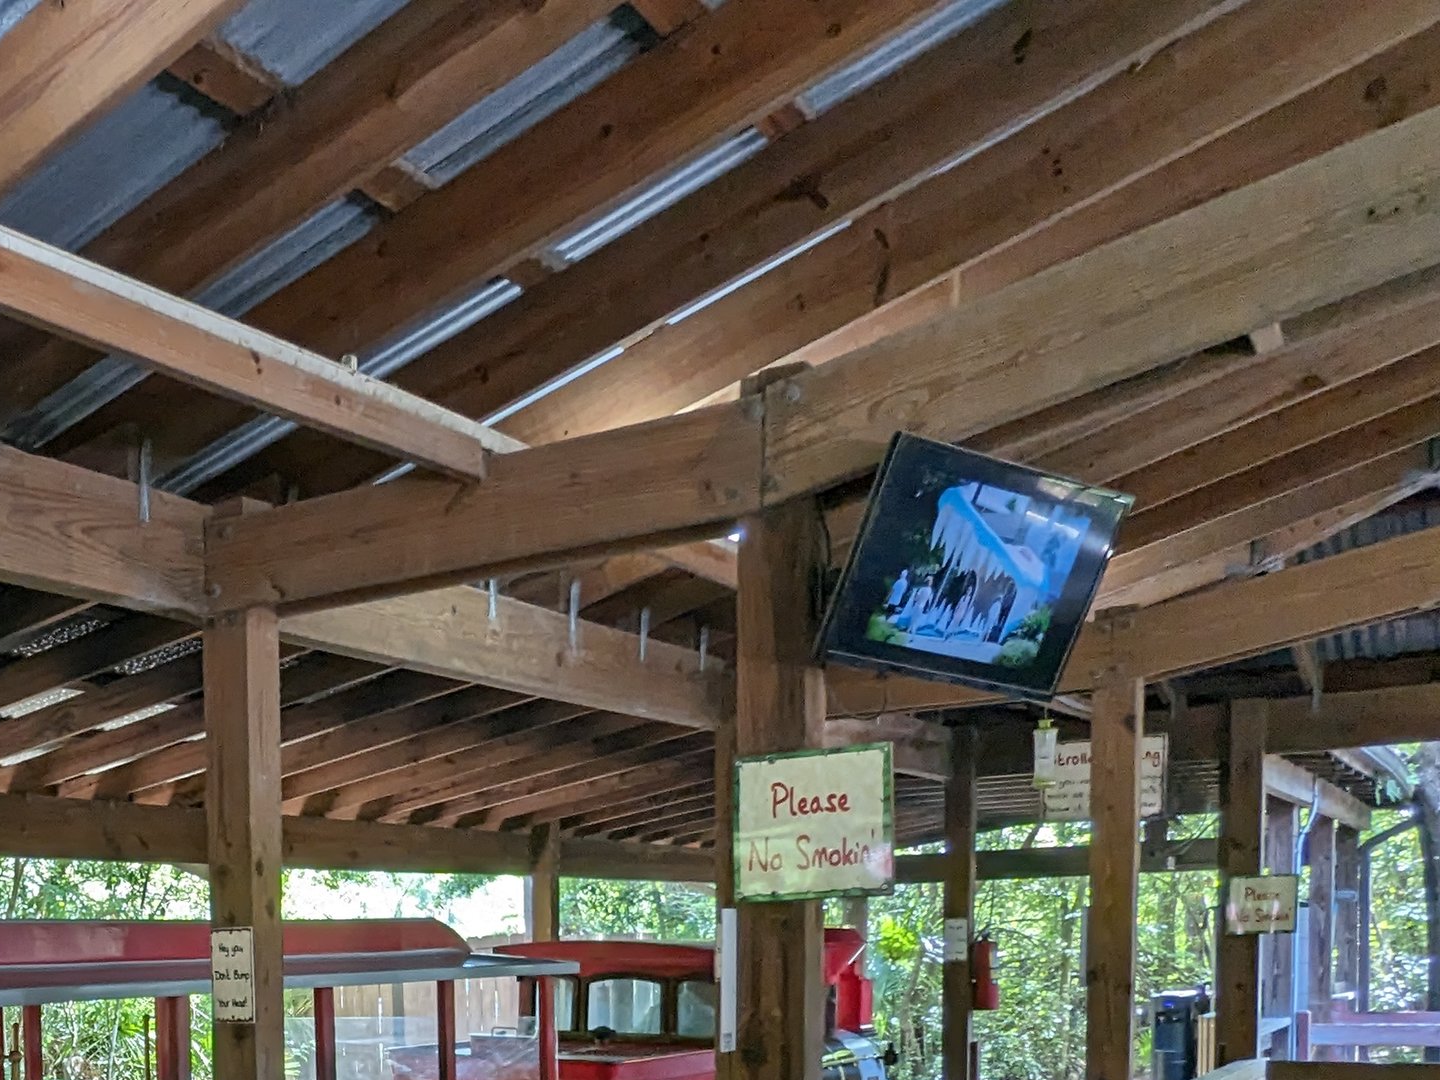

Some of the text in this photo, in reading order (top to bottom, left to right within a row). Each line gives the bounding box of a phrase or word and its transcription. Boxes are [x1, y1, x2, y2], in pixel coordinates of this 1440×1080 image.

[770, 781, 852, 819] Please
[748, 837, 783, 873] No
[218, 943, 230, 958] Hey
[233, 969, 250, 983] Bump
